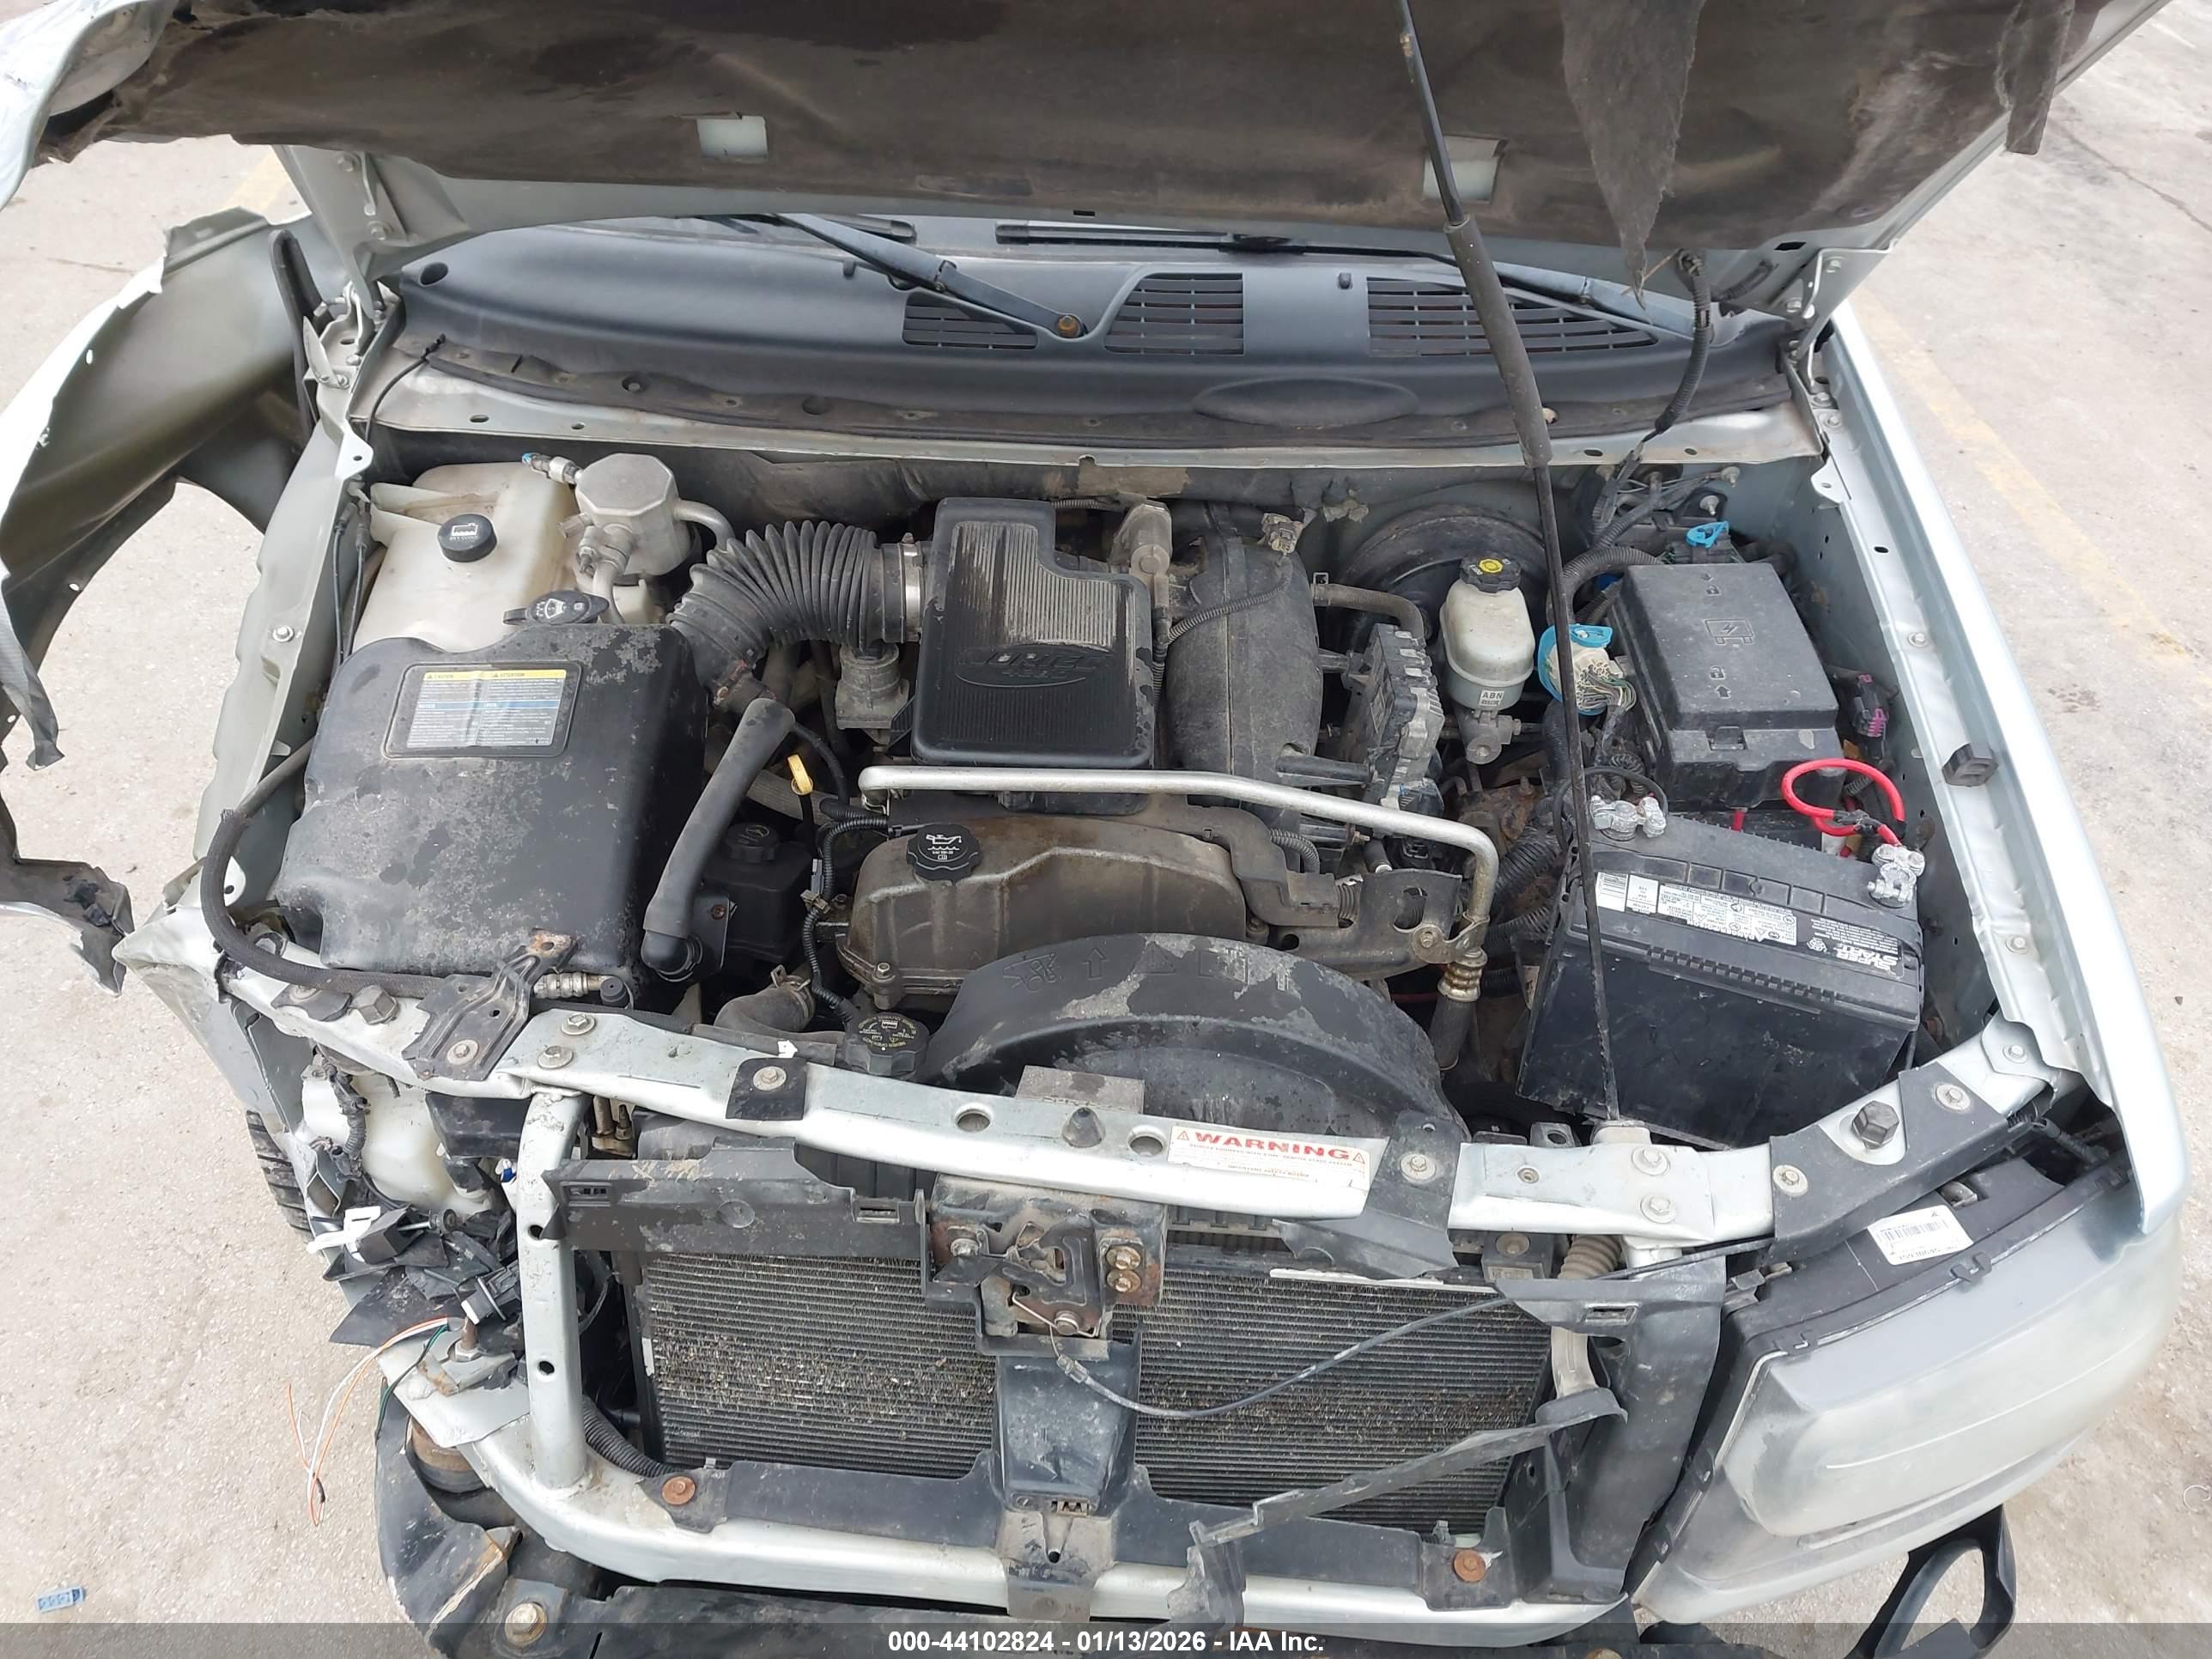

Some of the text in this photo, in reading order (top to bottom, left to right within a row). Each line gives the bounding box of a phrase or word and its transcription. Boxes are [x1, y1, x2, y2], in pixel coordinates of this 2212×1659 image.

[1482, 691, 1504, 700] ABN
[1833, 943, 1899, 966] START
[1836, 951, 1891, 970] SUPER
[1194, 1132, 1350, 1160] WARNING
